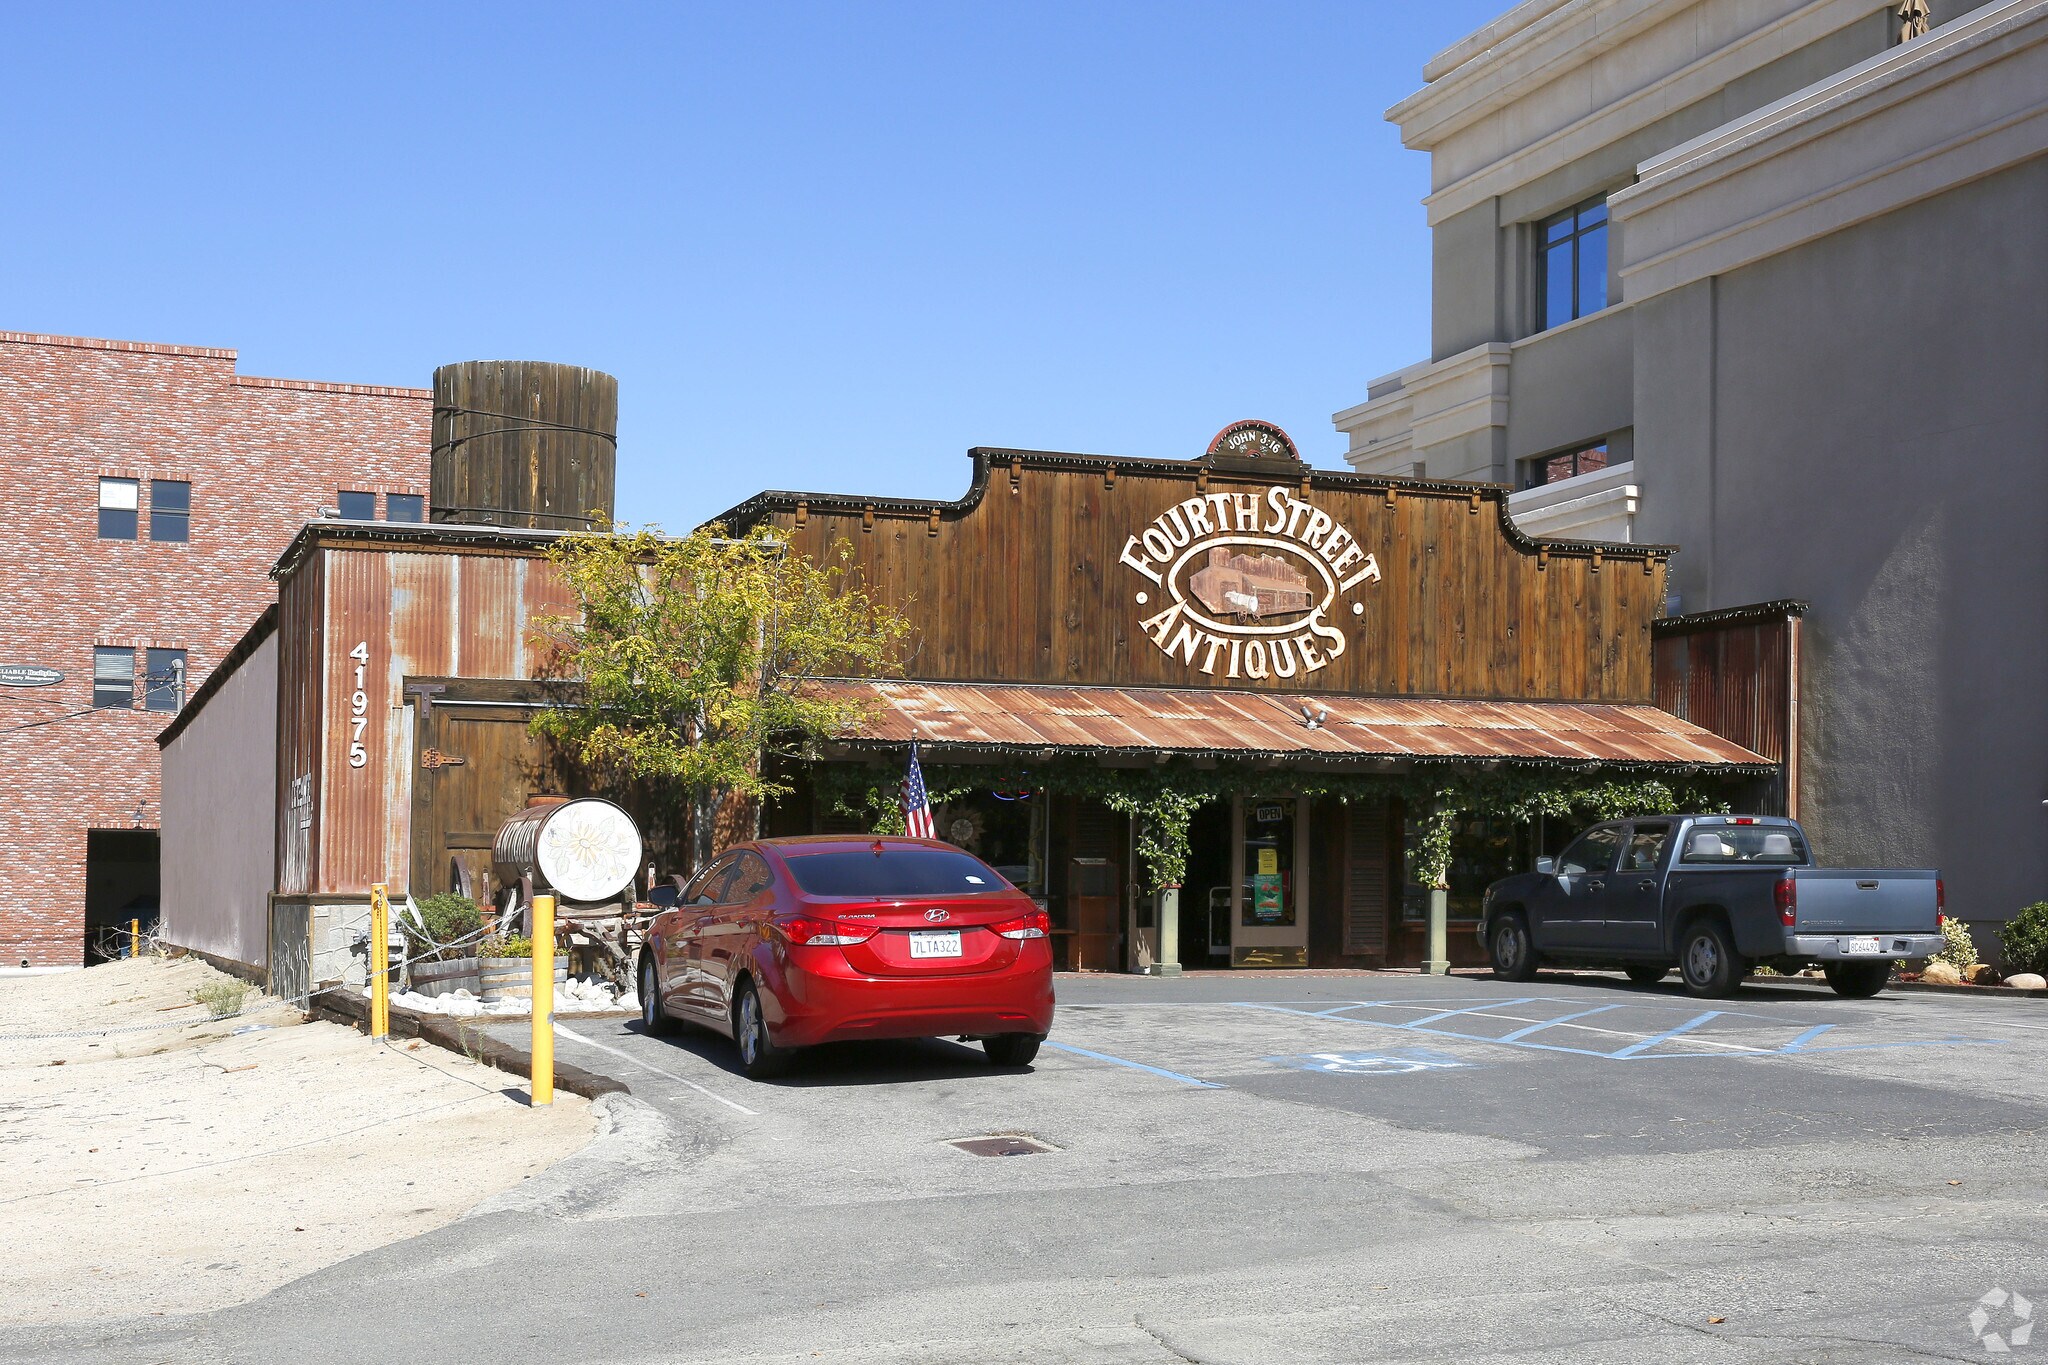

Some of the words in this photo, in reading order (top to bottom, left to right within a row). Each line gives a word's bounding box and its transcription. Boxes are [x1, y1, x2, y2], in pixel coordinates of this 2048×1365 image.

[1228, 431, 1256, 450] JOHN
[1260, 433, 1281, 454] 3:16
[1118, 492, 1262, 589] FOURTH
[1263, 485, 1382, 596] STREET
[1138, 599, 1346, 680] ANTIQUES
[349, 641, 369, 768] 41975
[1259, 807, 1281, 820] OPEN
[913, 940, 958, 954] 7LTA322
